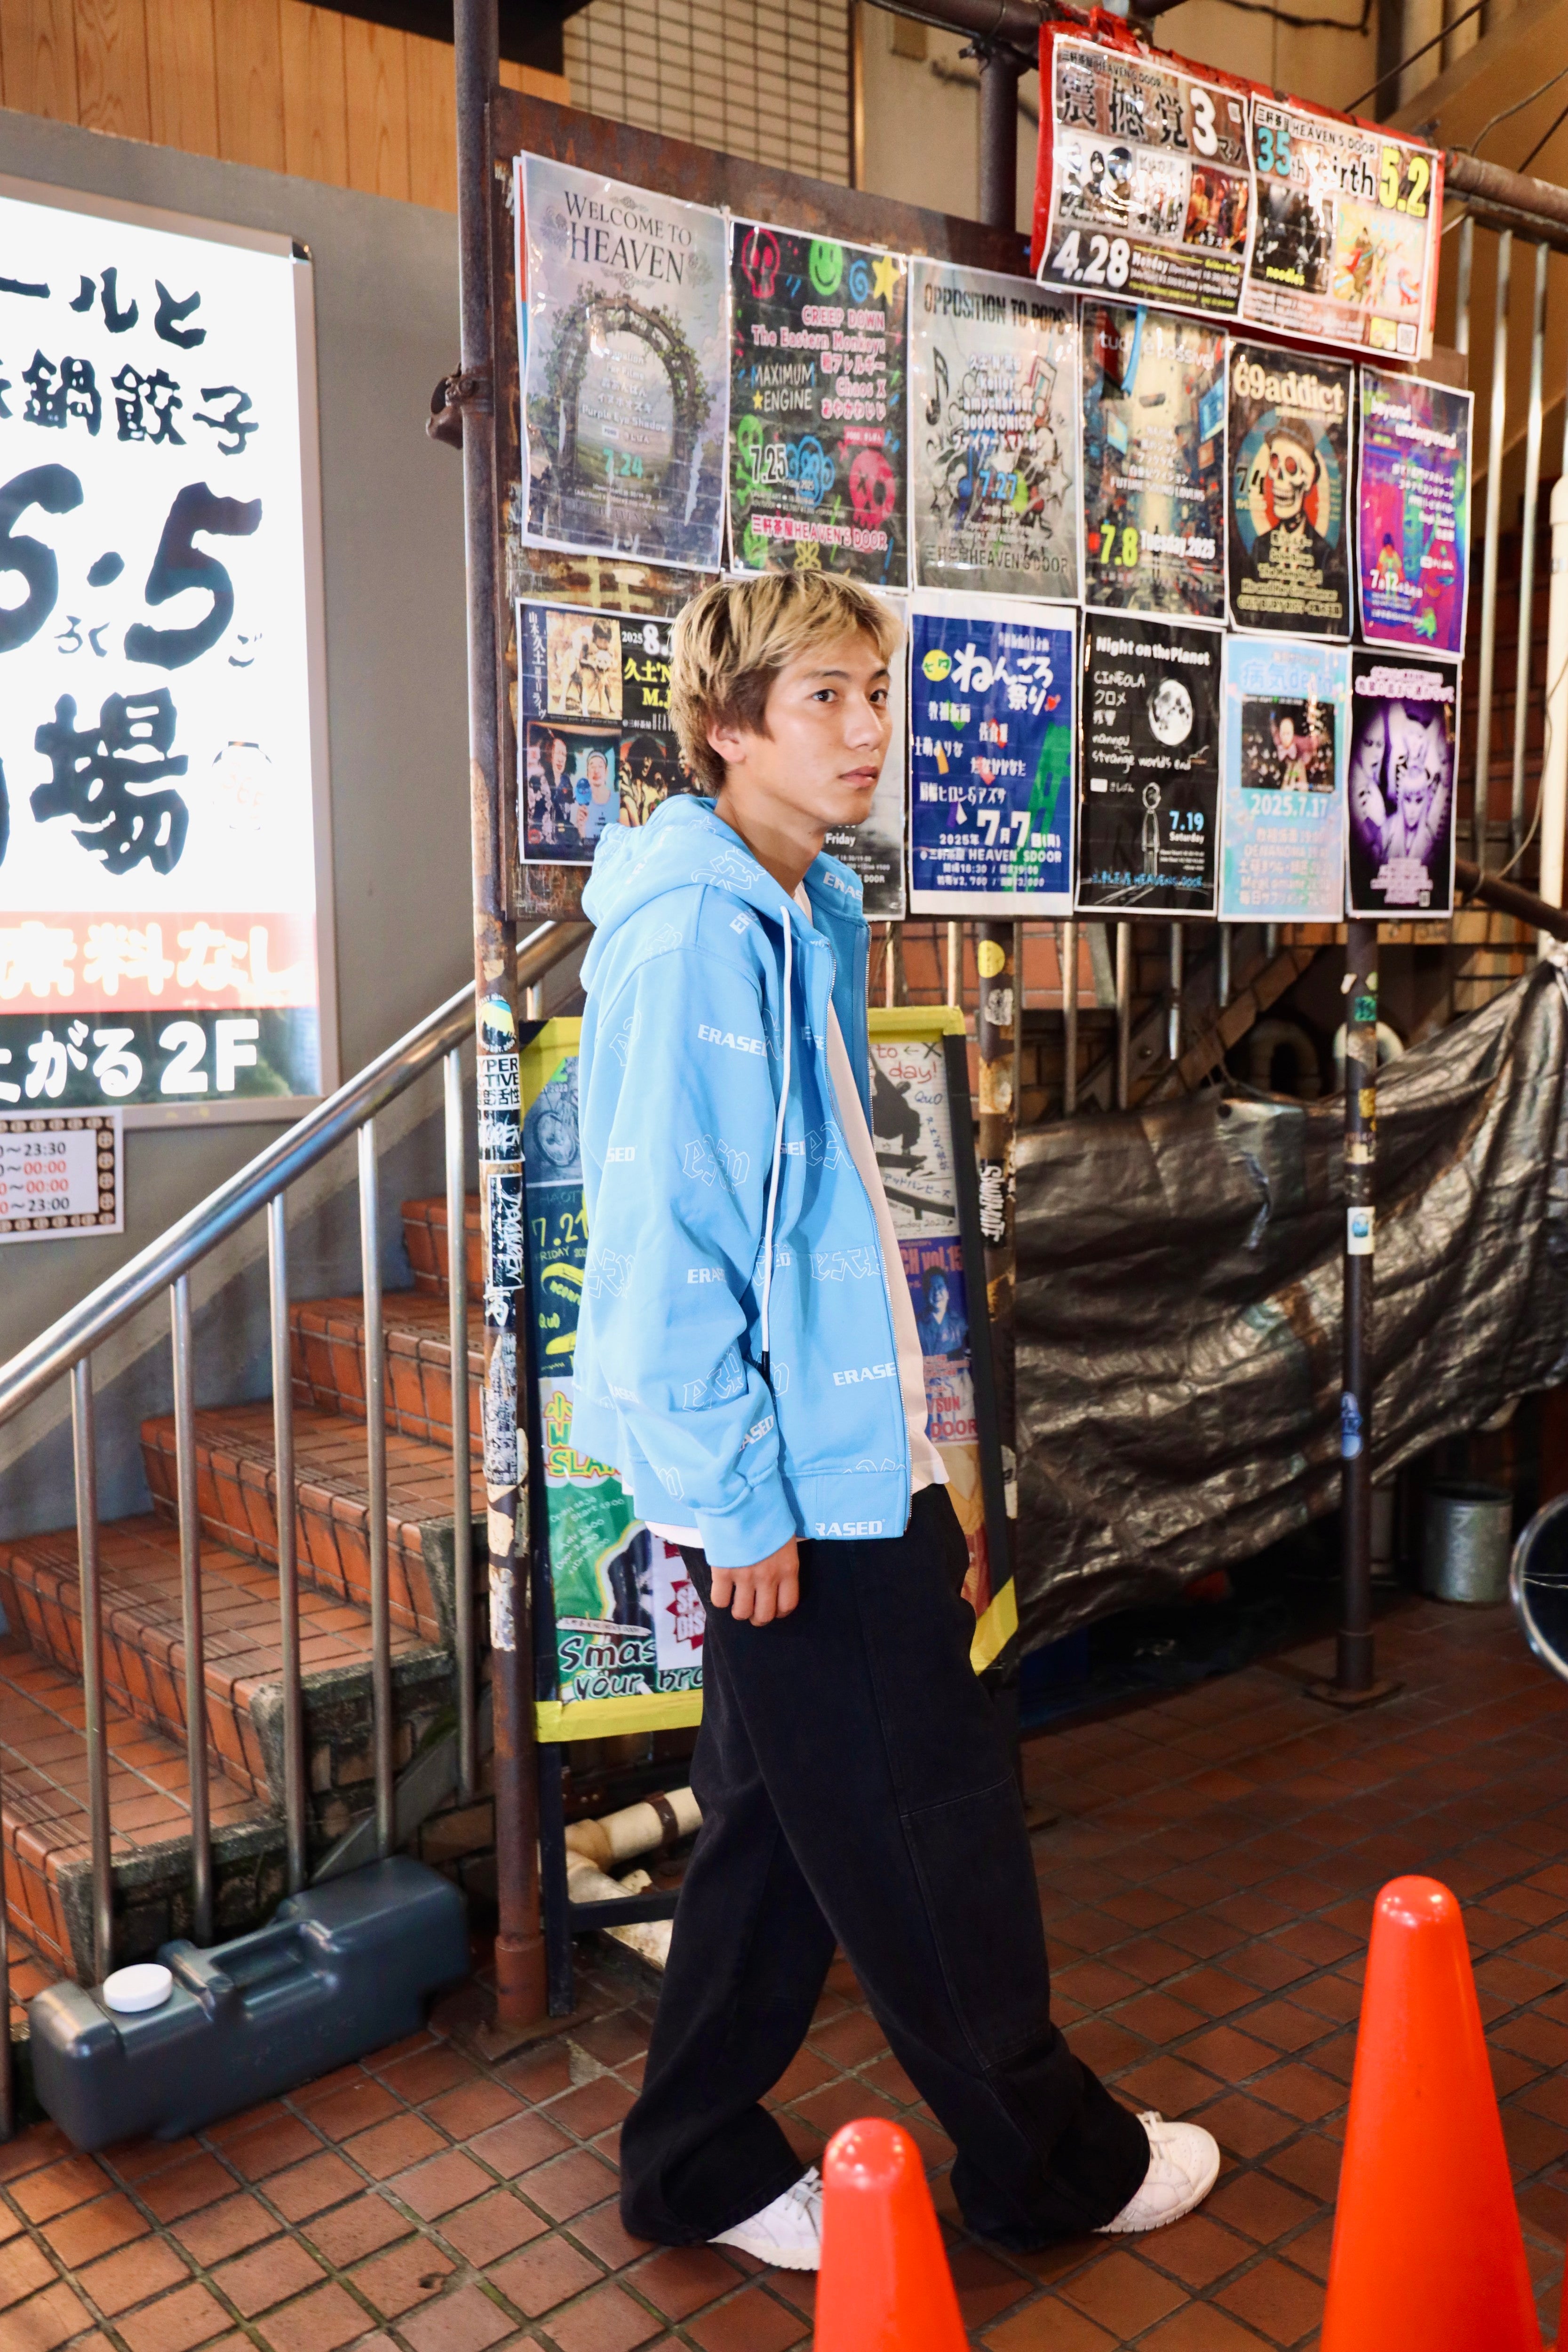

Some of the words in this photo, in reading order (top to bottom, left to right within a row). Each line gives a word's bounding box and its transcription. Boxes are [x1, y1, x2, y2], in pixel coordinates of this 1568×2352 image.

[1378, 146, 1429, 218] 5.2
[564, 190, 663, 239] WELCOME
[667, 223, 692, 247] TO
[570, 222, 685, 285] HEAVEN
[1051, 230, 1130, 288] 4.28
[801, 304, 845, 328] CREEP
[847, 308, 885, 332] DOWN
[751, 324, 777, 347] The
[780, 326, 830, 350] Eastern
[0, 348, 259, 456] 鍋餃子
[764, 388, 813, 413] ENGINE
[1233, 361, 1345, 414] 69addict
[748, 443, 788, 485] 7.25
[979, 469, 1018, 501] 7.27
[1100, 523, 1138, 567] 7.8
[622, 631, 644, 645] 2025
[1096, 636, 1135, 657] Night
[1135, 643, 1152, 658] on
[1152, 643, 1171, 661] the
[1170, 646, 1211, 667] Planet
[1007, 683, 1047, 716] 祭り
[0, 686, 189, 876] 場
[1169, 809, 1205, 832] 7.19
[1250, 794, 1329, 818] 2025.7.17
[825, 832, 856, 847] Friday
[1169, 831, 1205, 845] Saturday
[864, 874, 885, 883] DOOR
[158, 1018, 259, 1094] 2F
[876, 1044, 898, 1058] to
[889, 1061, 937, 1084] day!
[931, 1418, 979, 1438] DOOR
[574, 1673, 645, 1701] your
